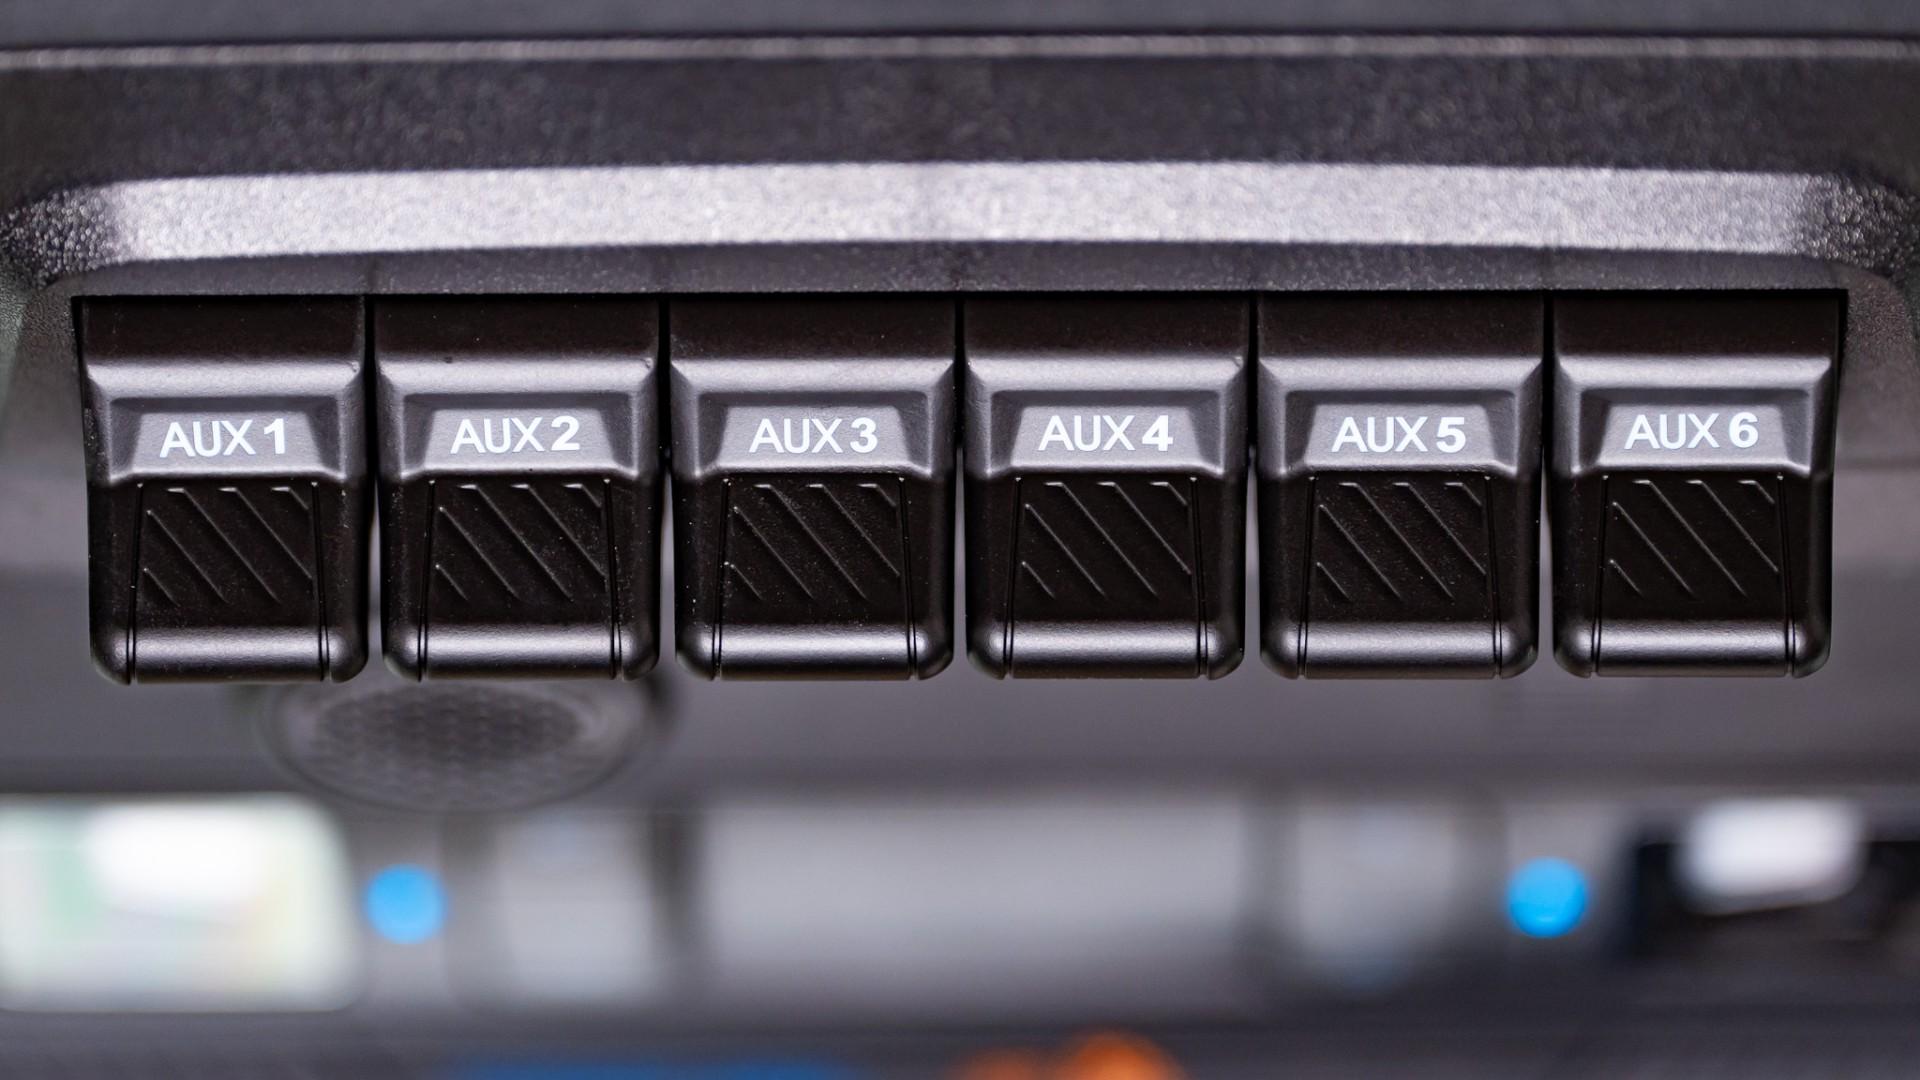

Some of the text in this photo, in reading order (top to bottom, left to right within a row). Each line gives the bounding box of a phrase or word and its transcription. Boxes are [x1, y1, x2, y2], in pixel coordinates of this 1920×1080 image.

[160, 417, 286, 458] AUX 1
[449, 415, 581, 455] AUX 2
[748, 416, 879, 454] AUX 3
[1036, 414, 1174, 452] AUX 4
[1331, 416, 1467, 454] AUX 5
[1623, 411, 1759, 450] AUX 6
